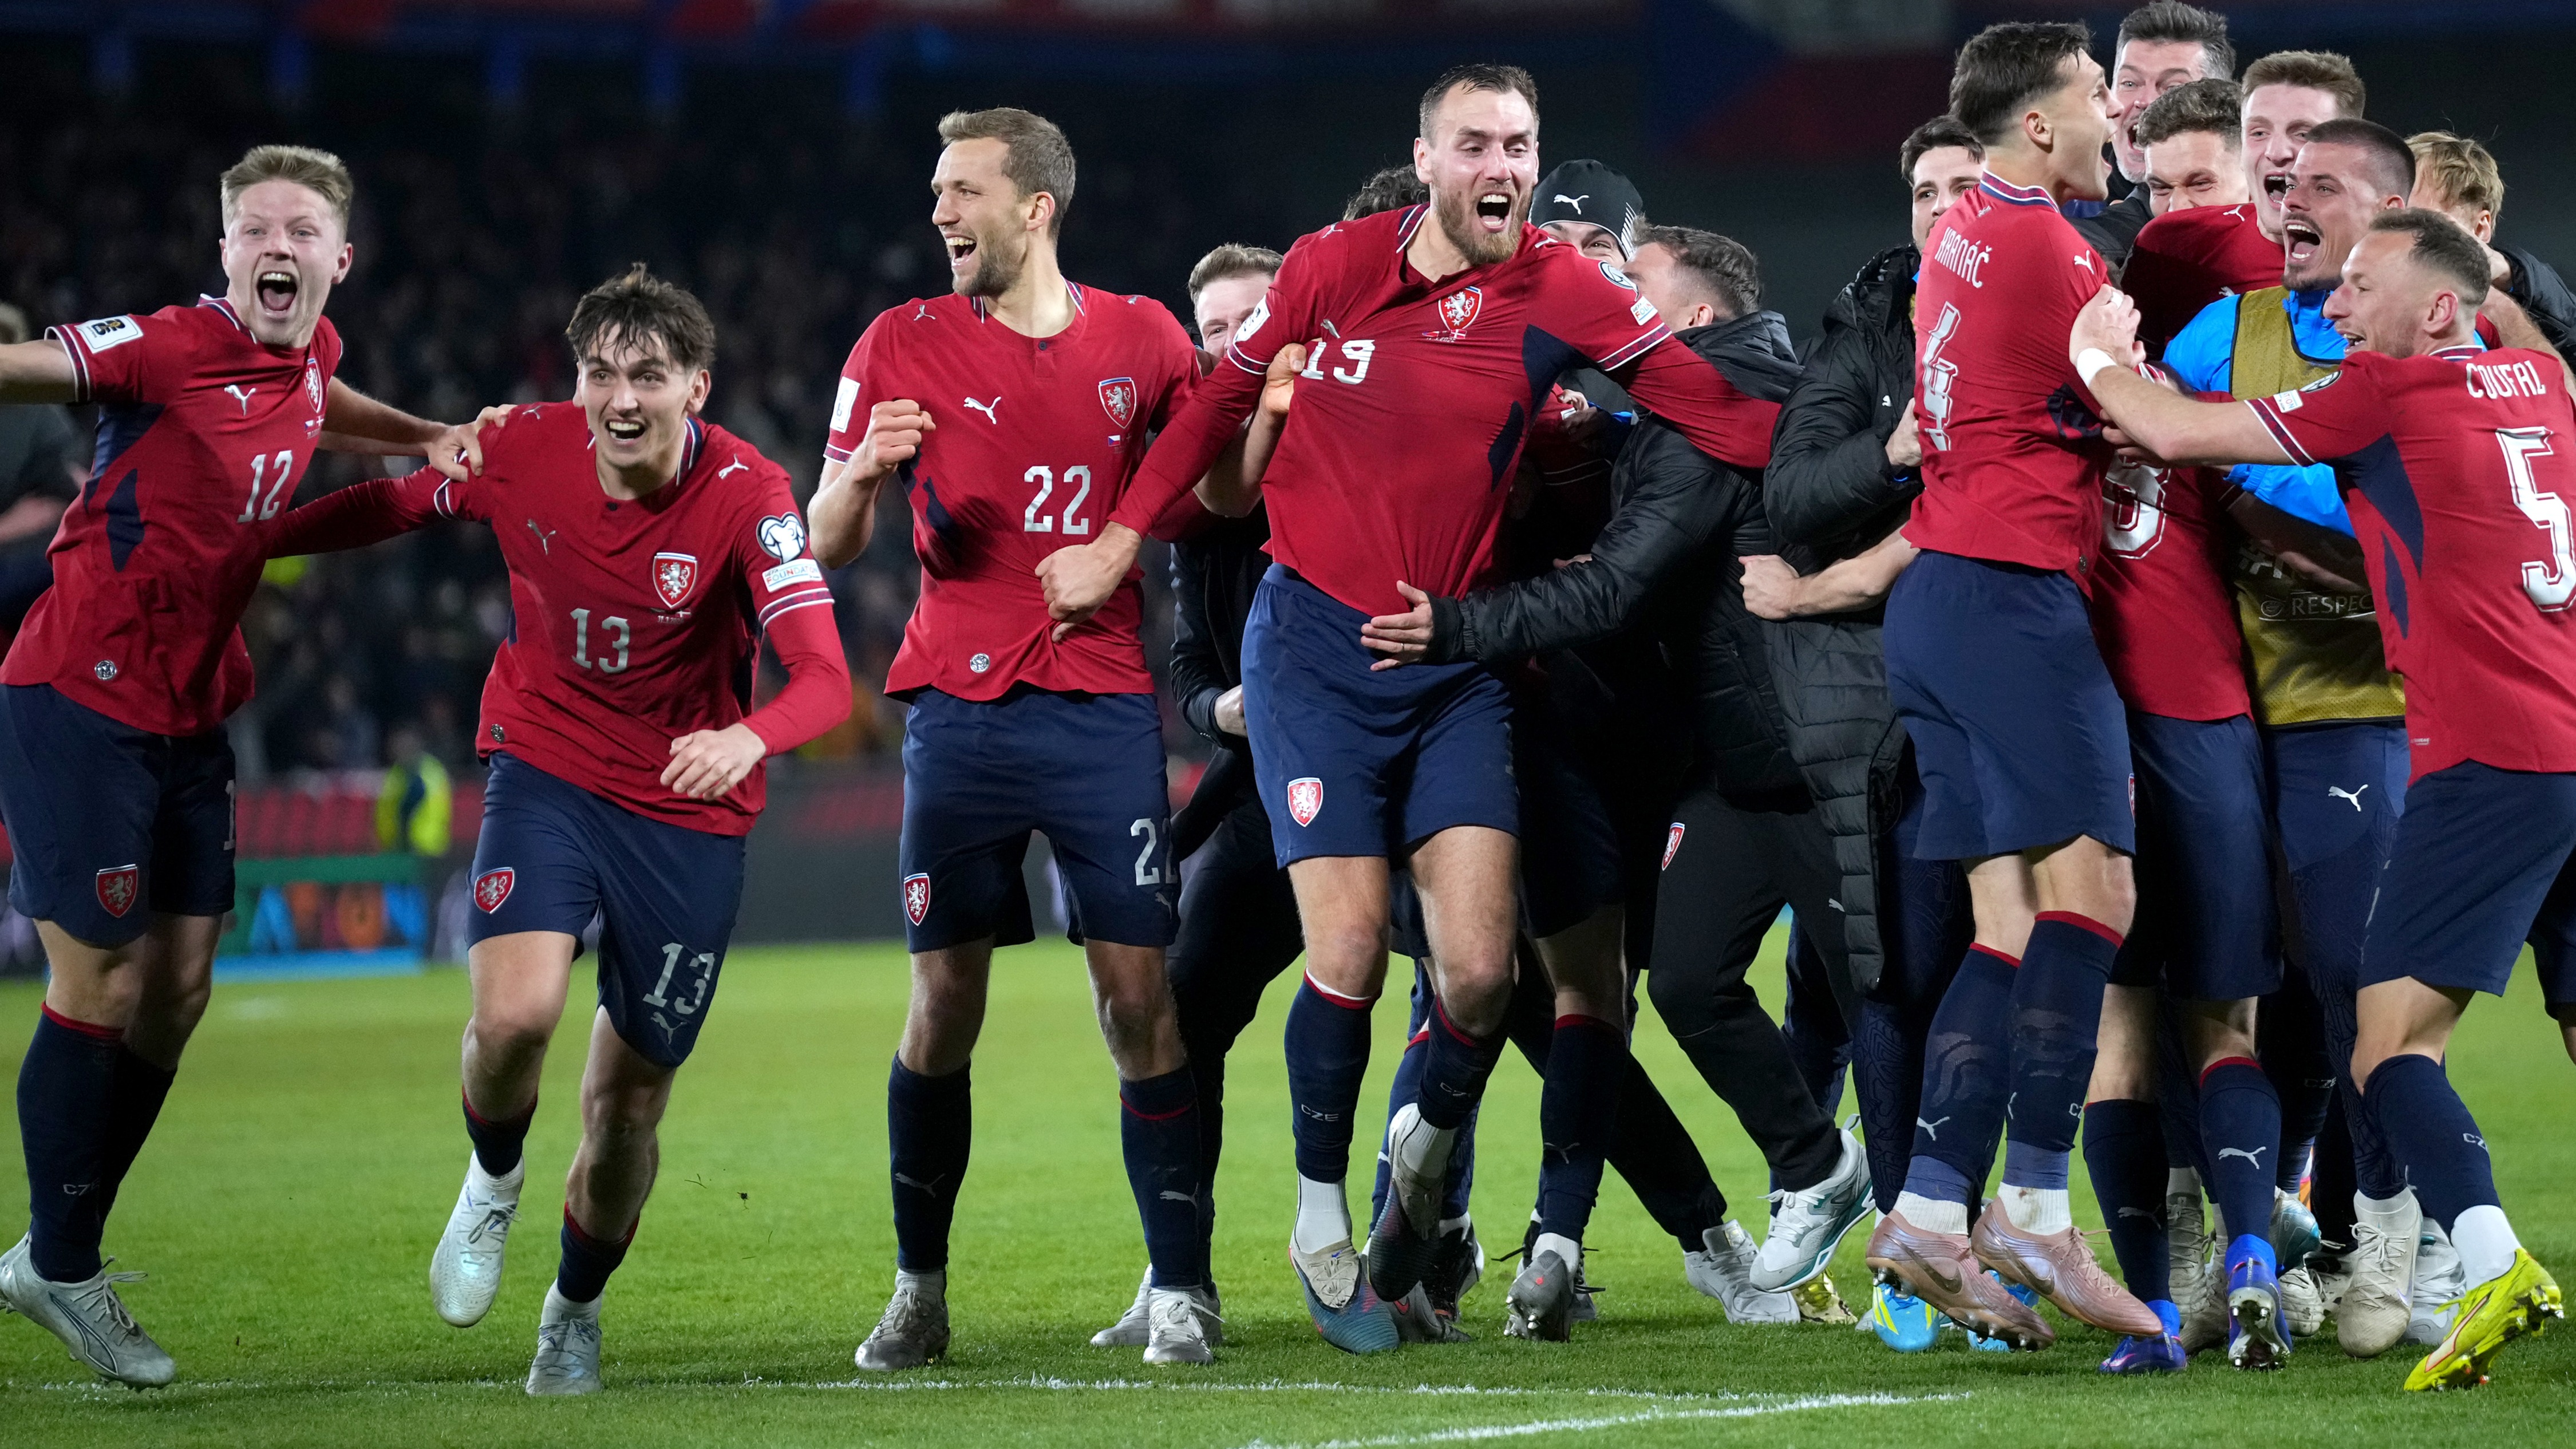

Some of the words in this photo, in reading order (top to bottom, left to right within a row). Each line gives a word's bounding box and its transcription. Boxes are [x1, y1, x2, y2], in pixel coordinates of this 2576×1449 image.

[1300, 339, 1376, 385] 19
[1922, 301, 1961, 451] 4
[2466, 360, 2546, 400] COUFAL
[238, 449, 293, 523] 12
[1024, 465, 1091, 535] 22
[2495, 426, 2576, 613] 5
[2291, 593, 2374, 616] RESPEC
[570, 607, 630, 674] 13
[223, 779, 235, 851] 1
[642, 942, 715, 1016] 13
[1301, 1104, 1340, 1122] CZE
[2463, 1133, 2488, 1151] CZ
